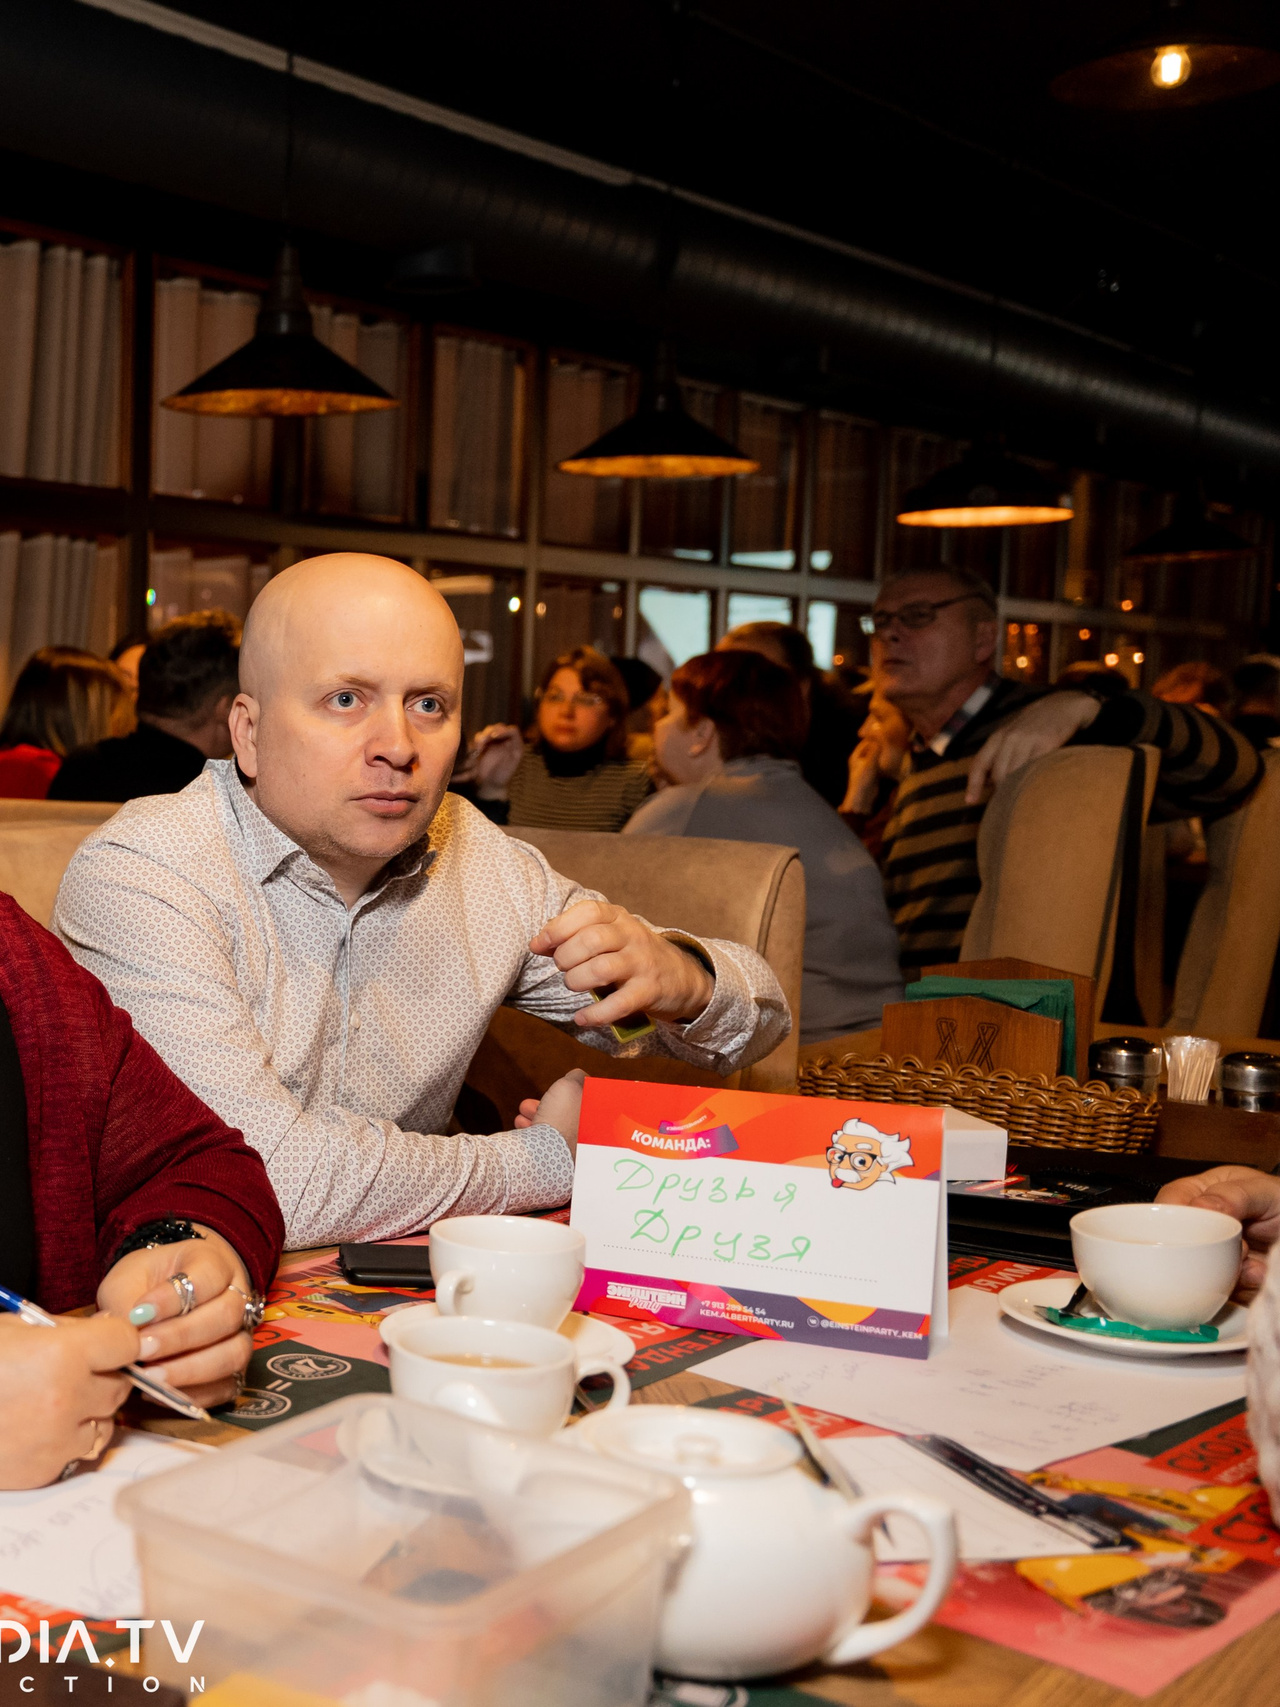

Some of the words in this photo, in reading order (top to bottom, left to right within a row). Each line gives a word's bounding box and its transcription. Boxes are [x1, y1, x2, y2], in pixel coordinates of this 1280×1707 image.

[631, 1129, 711, 1152] КОМАНДА:
[700, 1308, 795, 1329] KEM.ALBERTPARTY.RU
[820, 1319, 923, 1340] @EINSTEINPARTY_KEM
